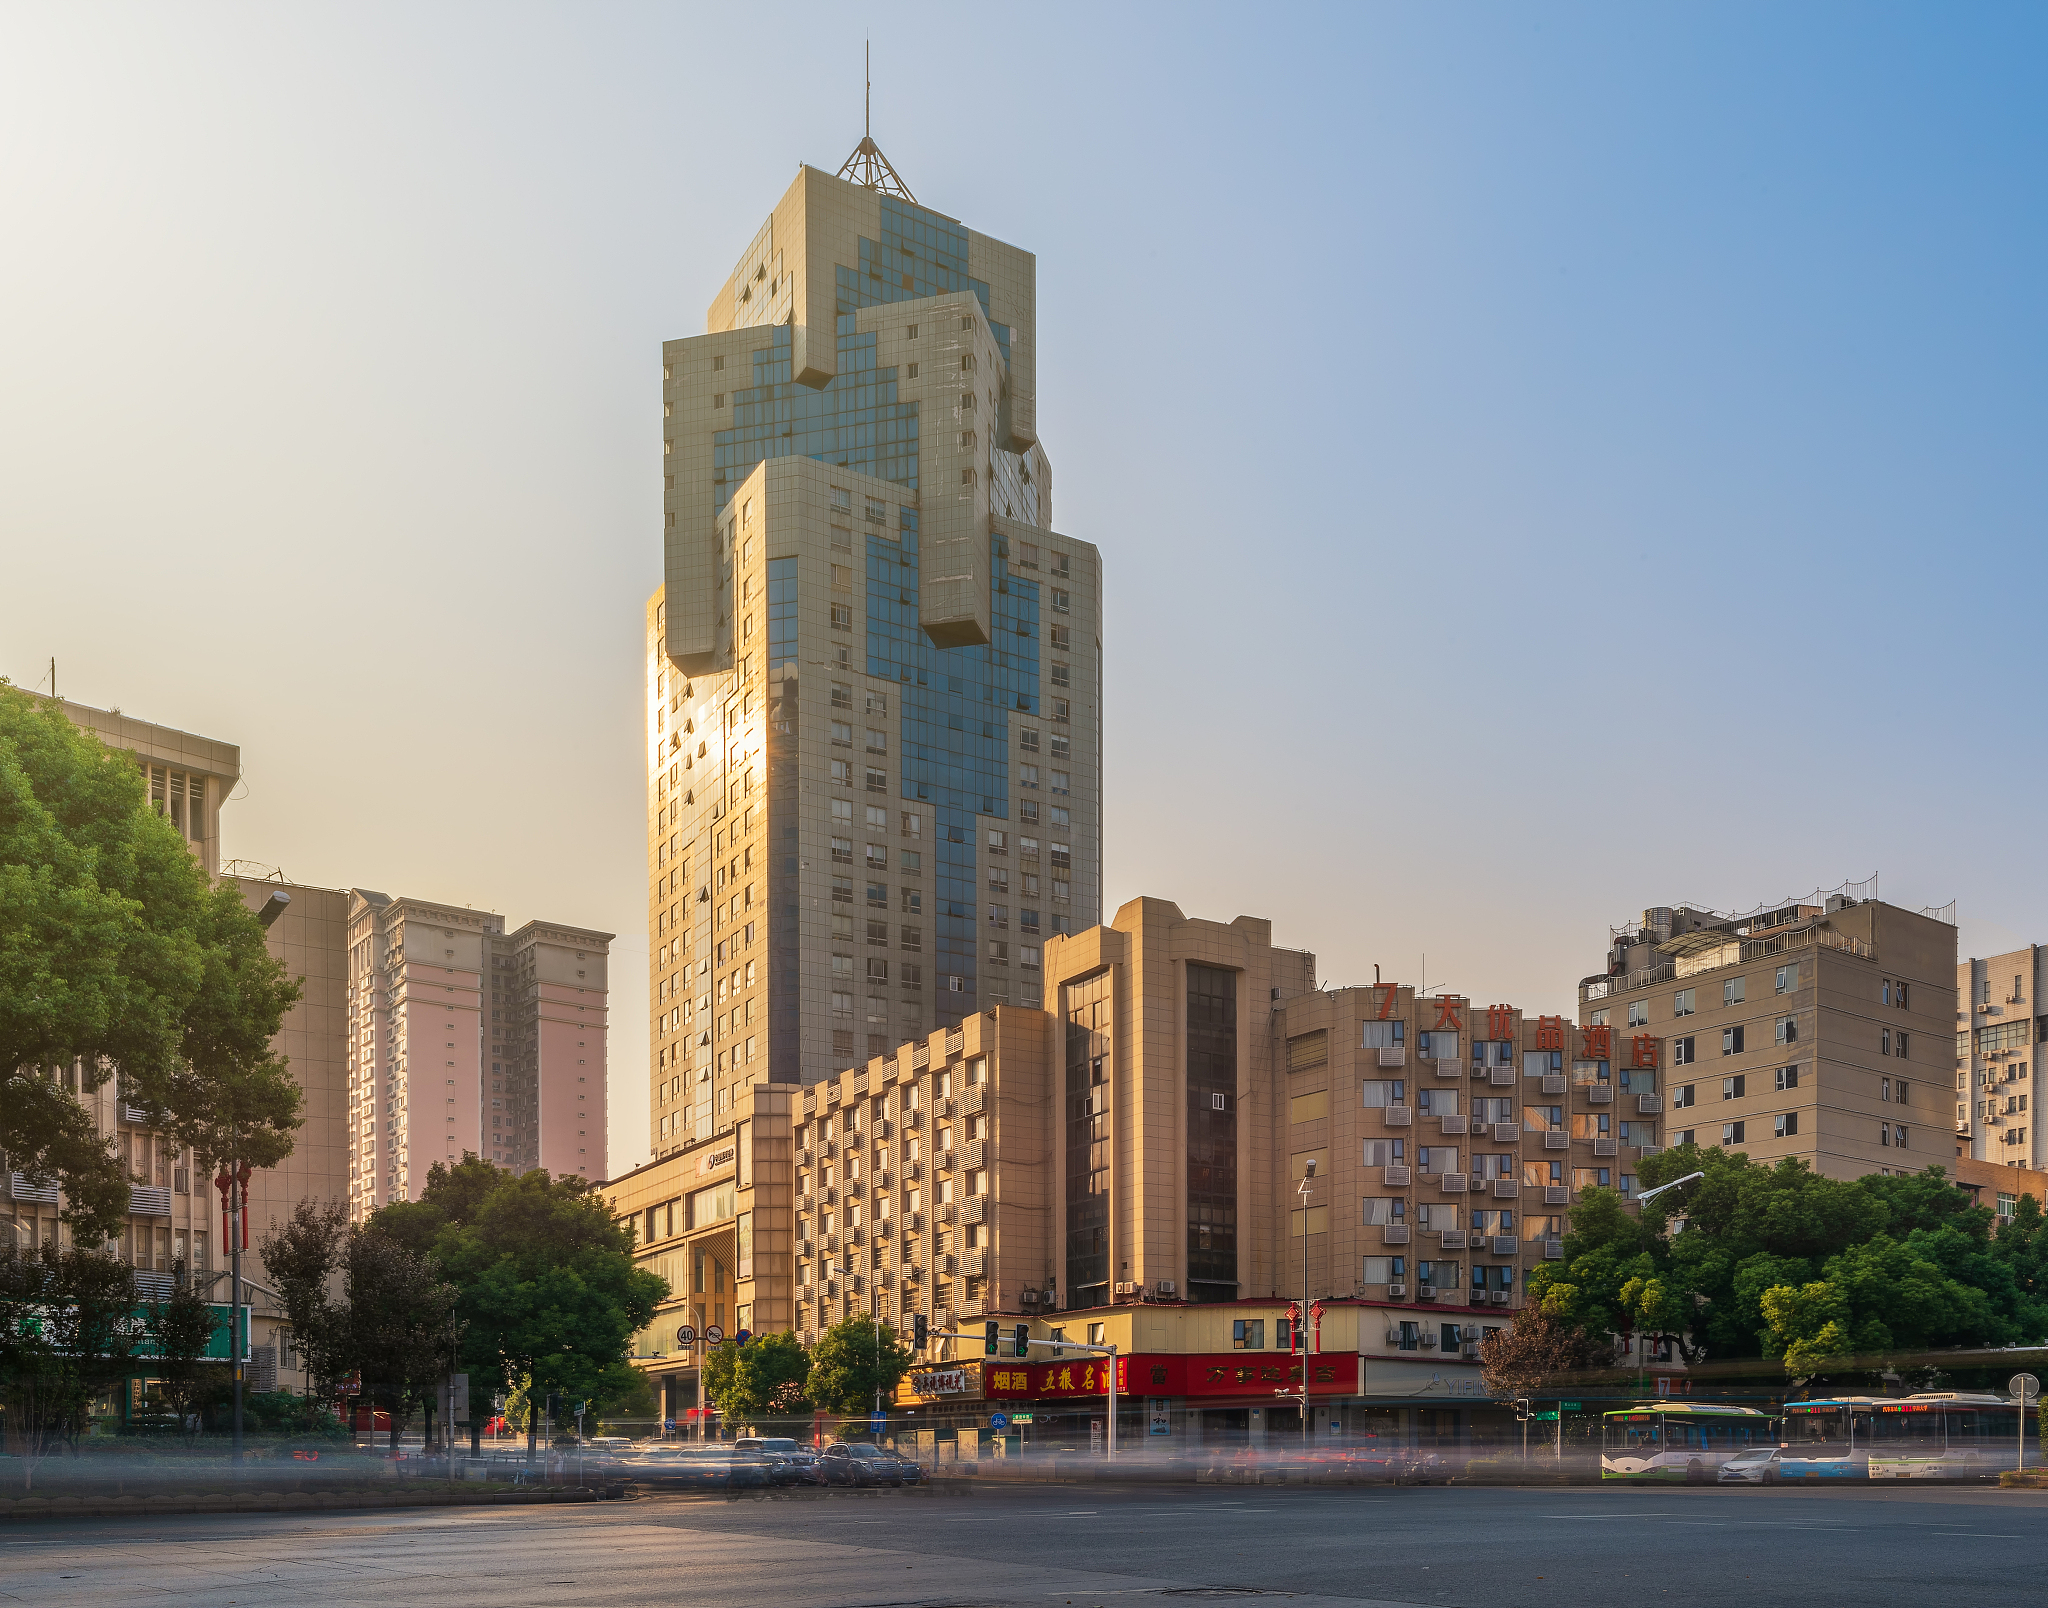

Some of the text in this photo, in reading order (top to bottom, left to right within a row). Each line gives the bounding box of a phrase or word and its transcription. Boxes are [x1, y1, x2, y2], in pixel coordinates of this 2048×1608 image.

[1373, 983, 1660, 1067] 7天优品酒店
[681, 1331, 692, 1340] 40
[993, 1371, 1028, 1391] 烟酒
